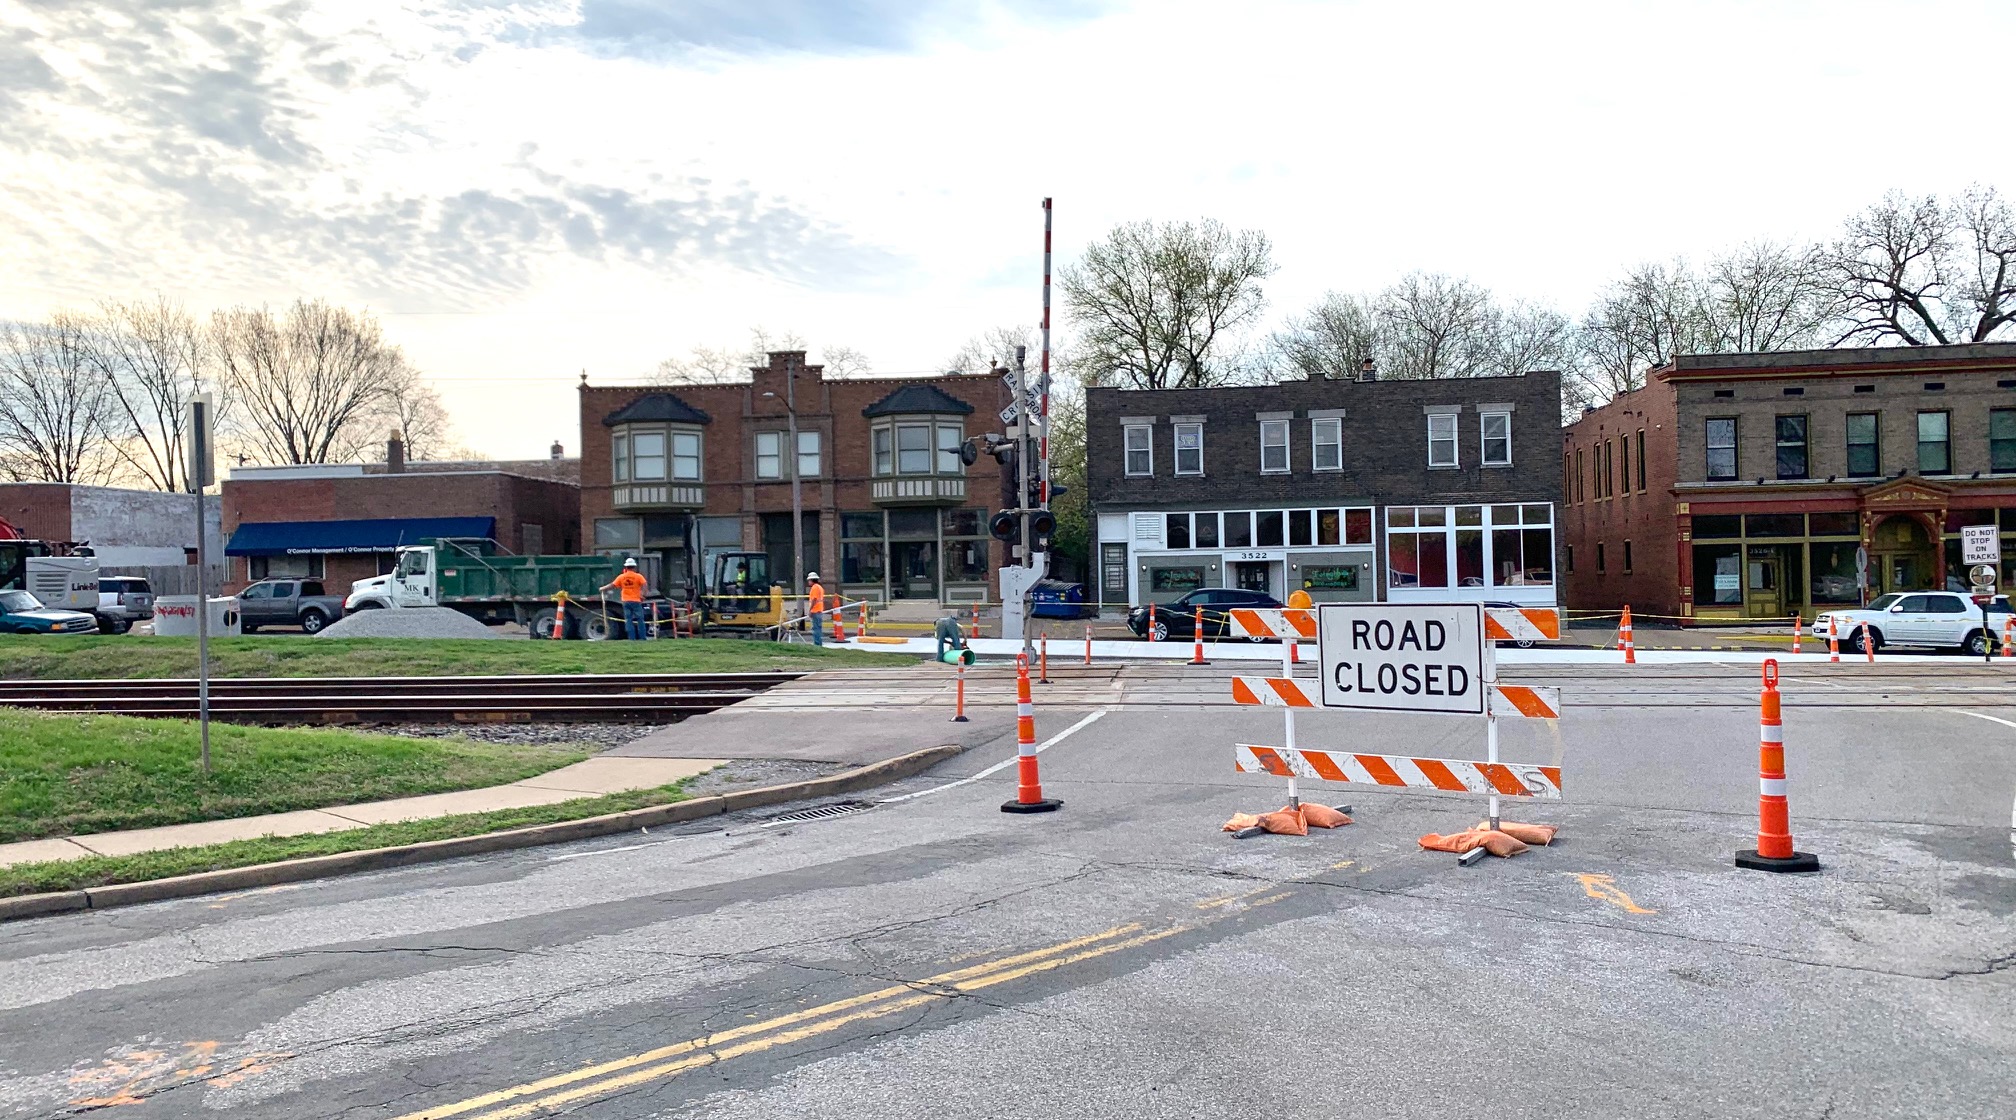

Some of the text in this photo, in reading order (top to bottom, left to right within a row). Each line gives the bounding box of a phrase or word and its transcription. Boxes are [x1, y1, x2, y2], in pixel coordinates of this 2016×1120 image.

[1002, 378, 1052, 421] CROSIN
[1005, 373, 1042, 422] RAROA
[1241, 552, 1267, 560] 3522
[71, 582, 98, 591] Link-Bel
[1351, 619, 1446, 651] ROAD
[1334, 661, 1469, 696] CLOSED
